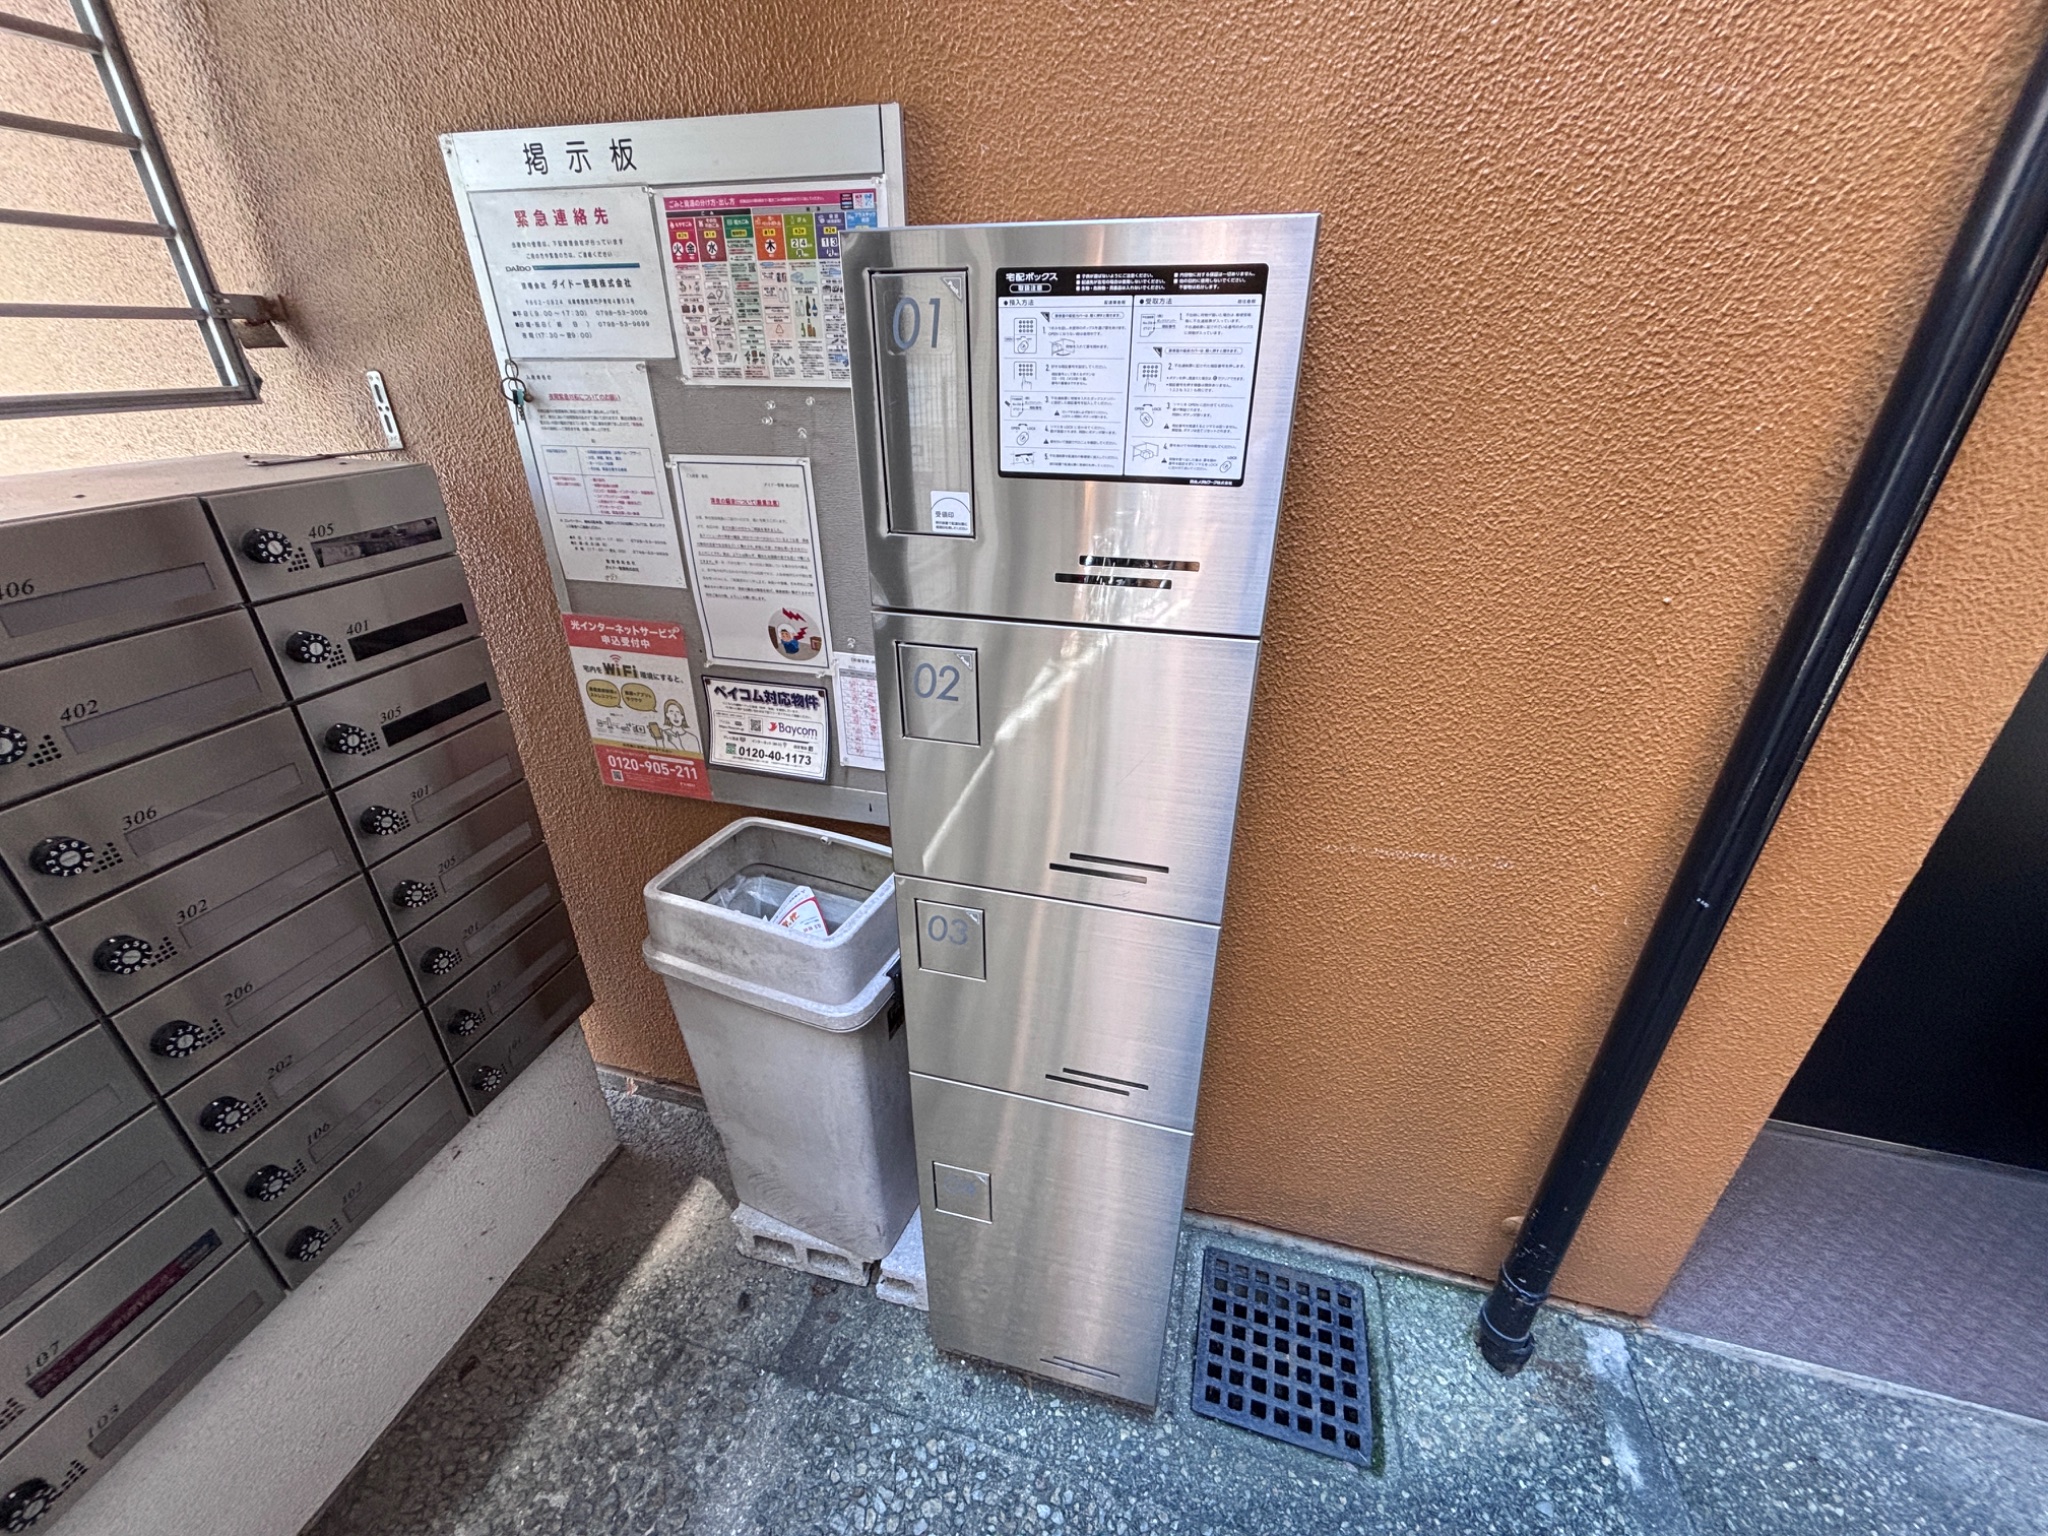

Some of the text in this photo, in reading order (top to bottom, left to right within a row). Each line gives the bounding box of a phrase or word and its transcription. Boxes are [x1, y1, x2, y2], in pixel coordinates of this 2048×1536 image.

[522, 138, 637, 176] 掲示板
[514, 207, 609, 228] 緊急連絡先
[706, 242, 717, 254] 水
[552, 278, 632, 290] ダイドー管理株式会社
[1005, 272, 1059, 282] 宅配ボックス
[892, 296, 941, 349] 01
[308, 523, 335, 539] 405
[346, 619, 370, 635] 401
[570, 620, 678, 640] 光インターネットサービス
[601, 634, 651, 649] 申込受付中
[913, 662, 961, 702] 02
[713, 685, 821, 711] ベイコム対応物件
[60, 699, 98, 721] 402
[380, 706, 402, 724] 305
[778, 721, 818, 738] Baycom
[738, 746, 812, 766] 0120-40-1173
[607, 754, 698, 781] 0120-905-211
[411, 784, 430, 801] 301
[122, 806, 158, 831] 306
[438, 855, 457, 874] 205
[176, 899, 209, 925] 302
[927, 914, 969, 946] 03
[223, 981, 254, 1007] 206
[267, 1054, 294, 1080] 202
[308, 1122, 330, 1145] 106
[25, 1340, 60, 1378] 107
[87, 1404, 119, 1439] 103
